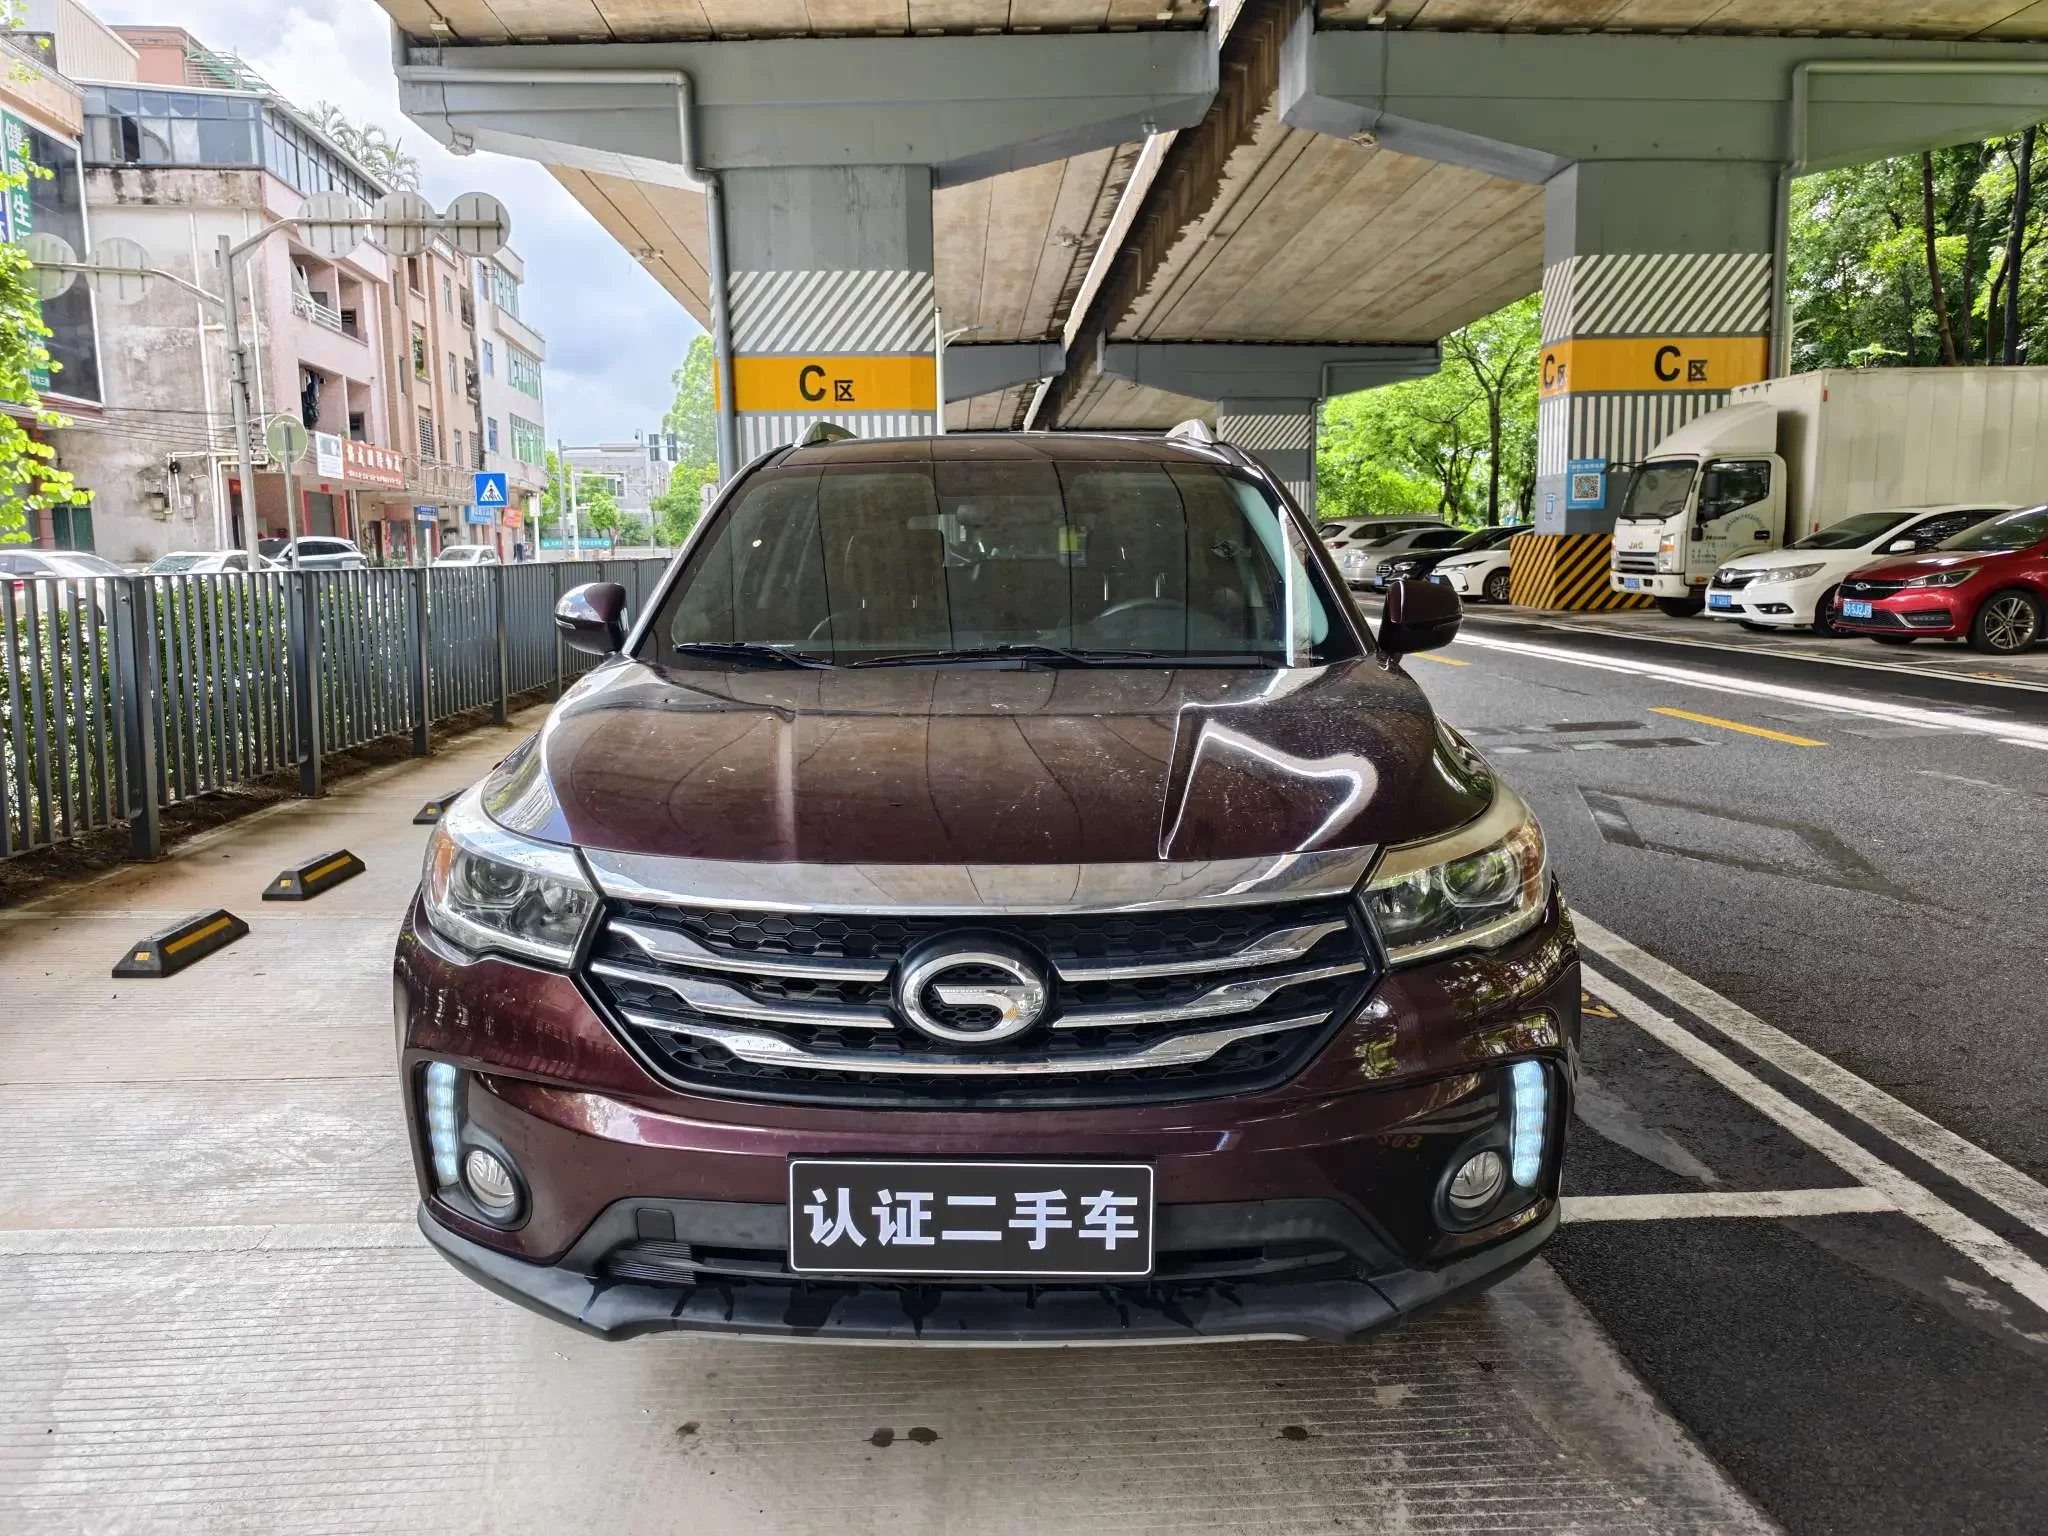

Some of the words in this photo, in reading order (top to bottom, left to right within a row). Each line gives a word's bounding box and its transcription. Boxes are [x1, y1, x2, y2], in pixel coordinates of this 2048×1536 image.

[1654, 345, 1708, 381] C区
[800, 365, 855, 401] C区
[803, 1187, 1139, 1251] 认证二手车
